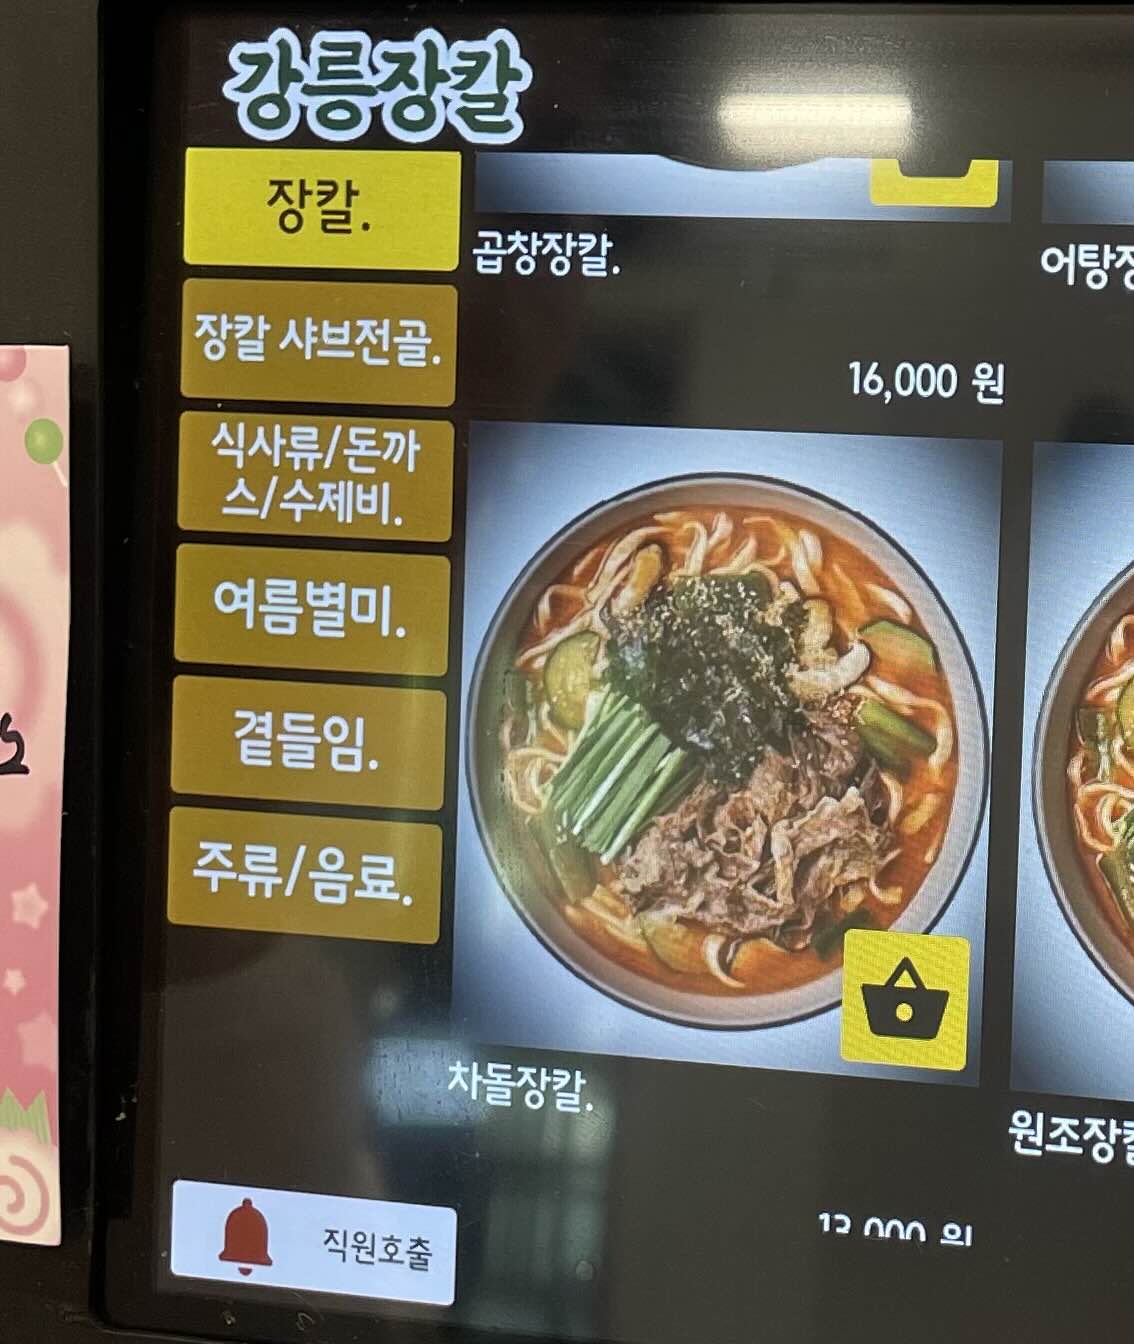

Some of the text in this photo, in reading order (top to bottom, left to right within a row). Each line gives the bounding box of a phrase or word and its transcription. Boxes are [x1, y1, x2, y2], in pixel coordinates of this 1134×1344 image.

[224, 27, 533, 144] 강릉장칼
[266, 178, 372, 235] 장칼.
[471, 229, 622, 278] 곱창장칼.
[194, 312, 442, 368] 장칼 샤브전골.
[848, 360, 1006, 406] 16,000 원
[210, 420, 422, 474] 식사류/돈까
[220, 476, 404, 527] 스/수제비.
[213, 576, 408, 639] 여름별미.
[233, 708, 380, 773] 곁들임.
[192, 840, 414, 907] 주류/음료.
[447, 1060, 595, 1114] 차돌장칼.
[322, 1227, 434, 1272] 직원호출
